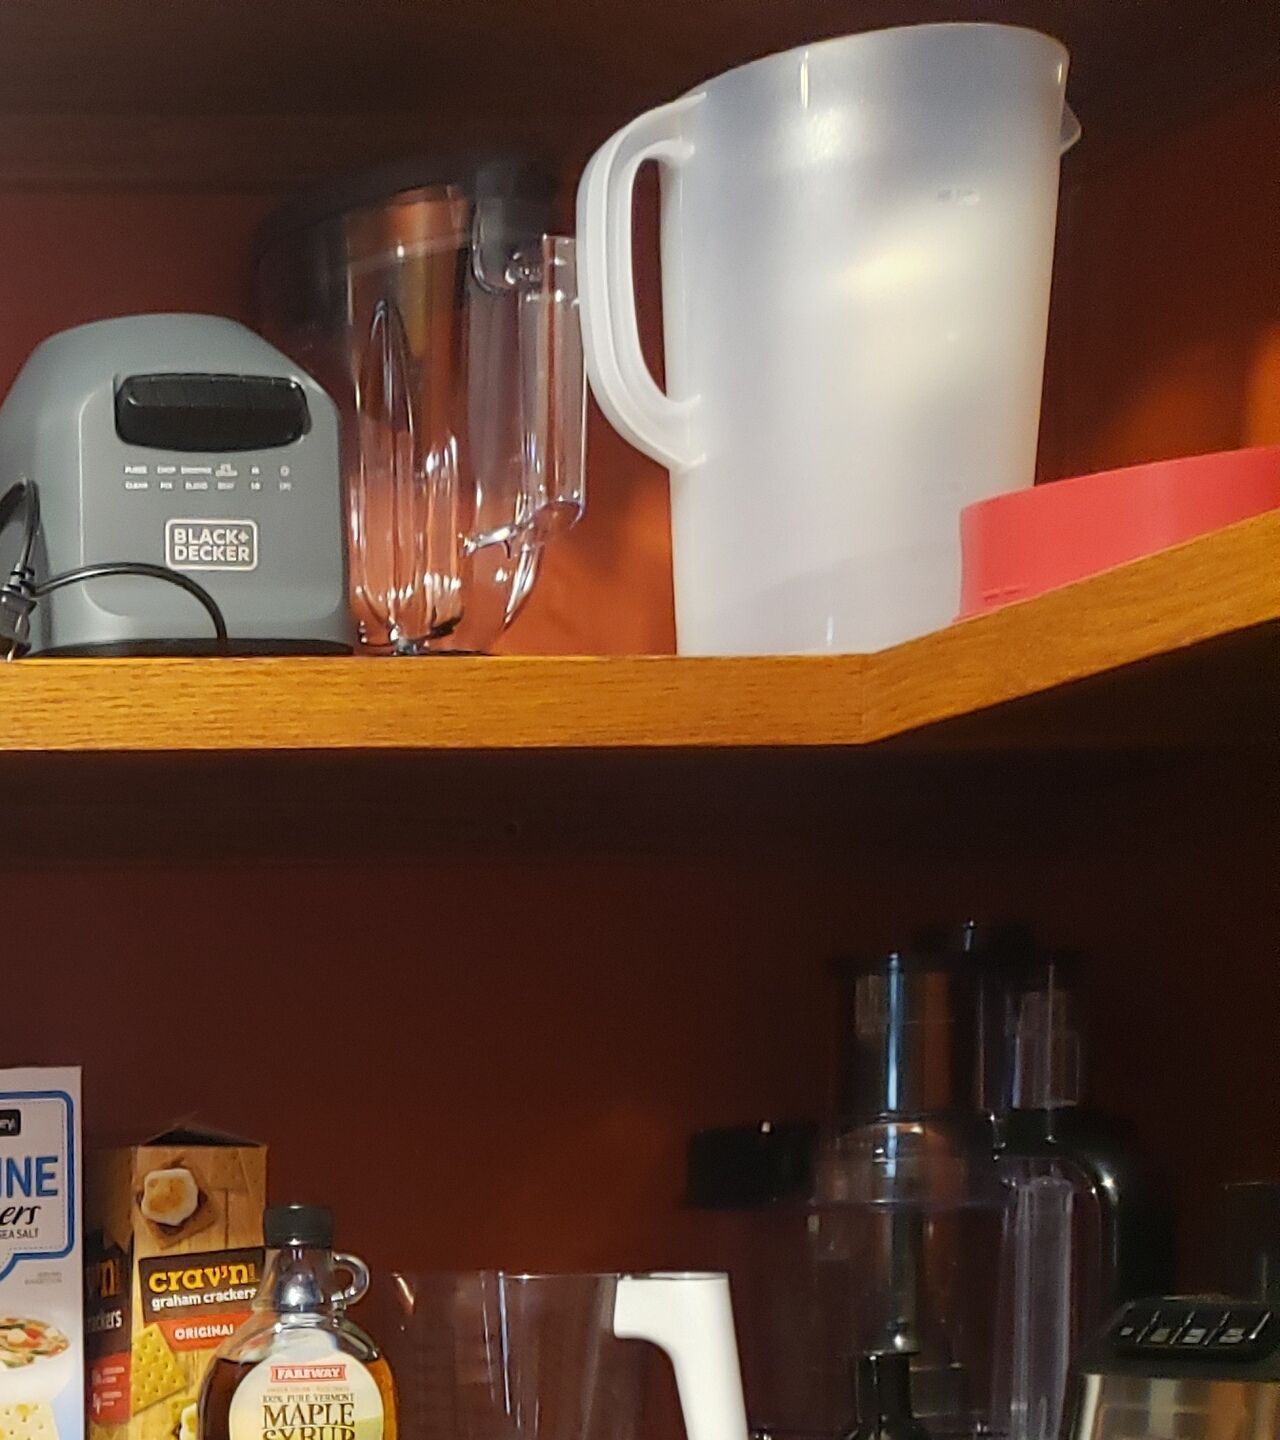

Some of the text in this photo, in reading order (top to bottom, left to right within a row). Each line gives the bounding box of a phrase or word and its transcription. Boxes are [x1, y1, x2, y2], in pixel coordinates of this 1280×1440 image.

[173, 528, 249, 545] BLACK+
[174, 545, 250, 562] DECKER
[16, 1228, 39, 1239] SALT
[151, 1294, 201, 1312] graham
[262, 1402, 355, 1430] MAPLE
